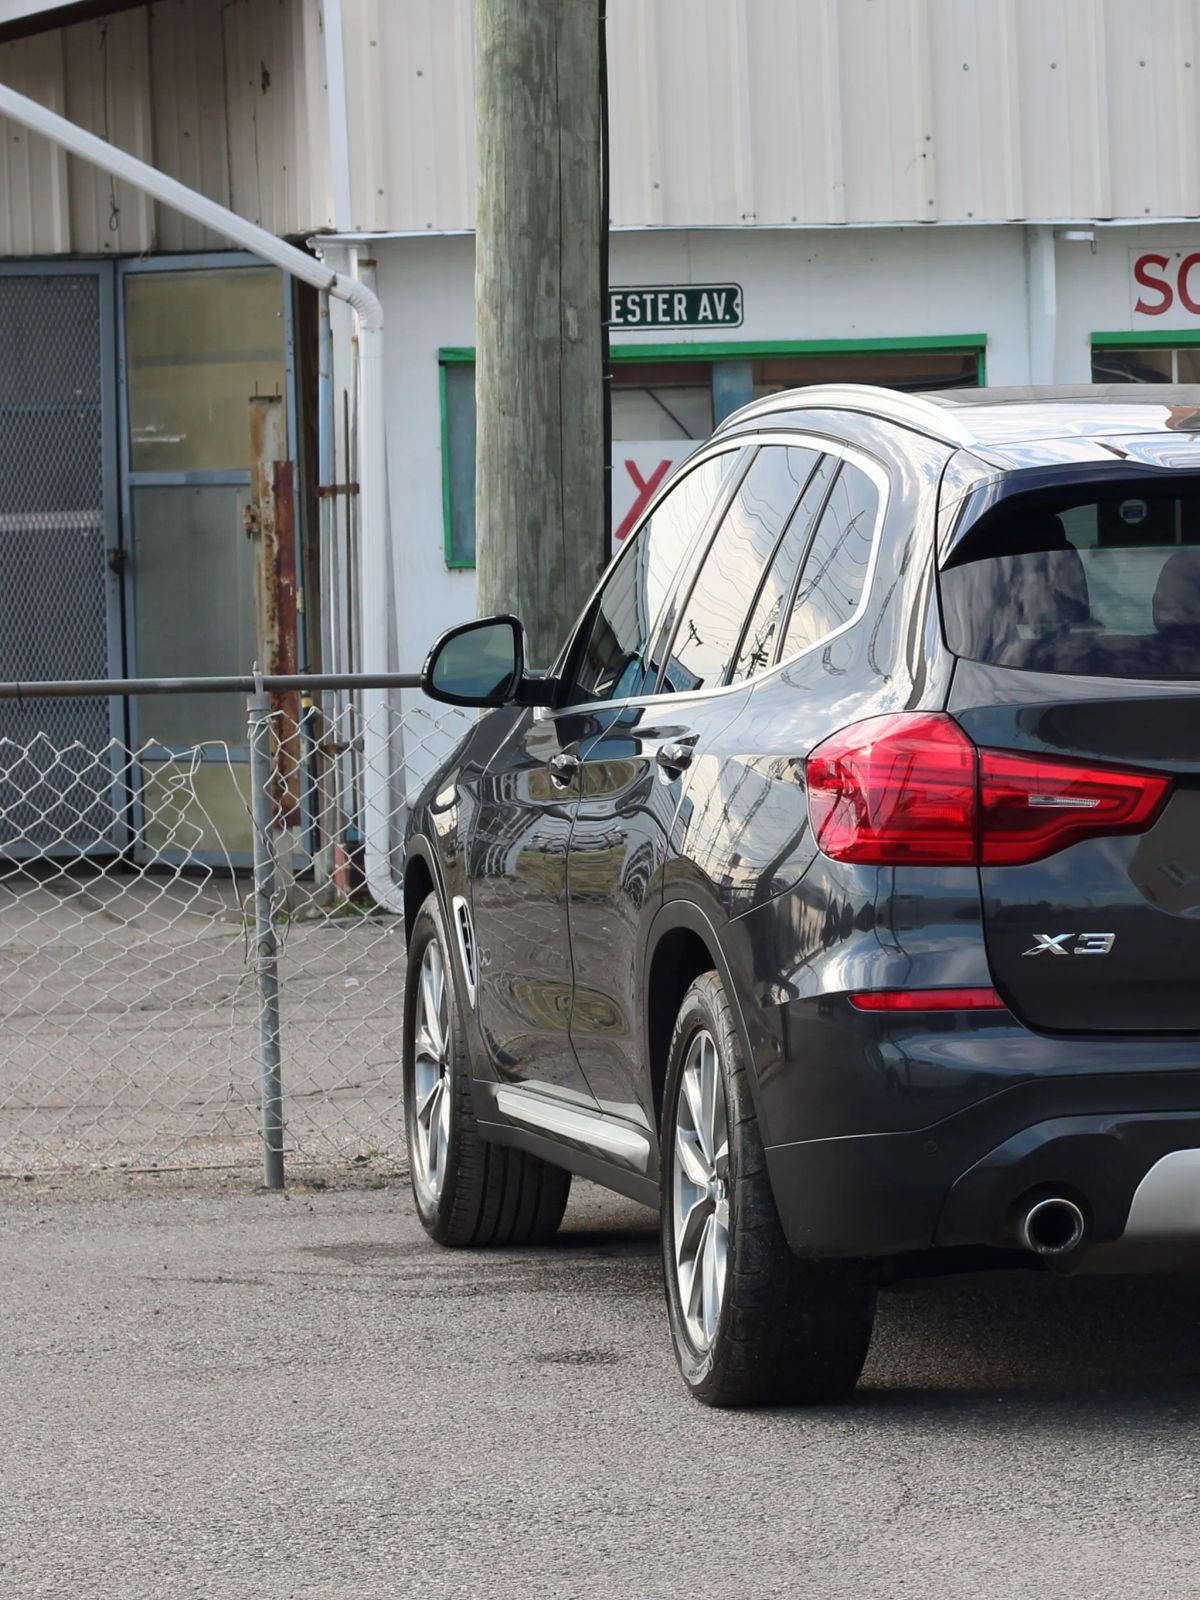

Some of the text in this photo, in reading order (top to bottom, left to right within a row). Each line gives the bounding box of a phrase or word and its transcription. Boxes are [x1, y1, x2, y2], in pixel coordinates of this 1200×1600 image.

[610, 292, 730, 323] ESTER AV.
[1021, 932, 1116, 956] X3
